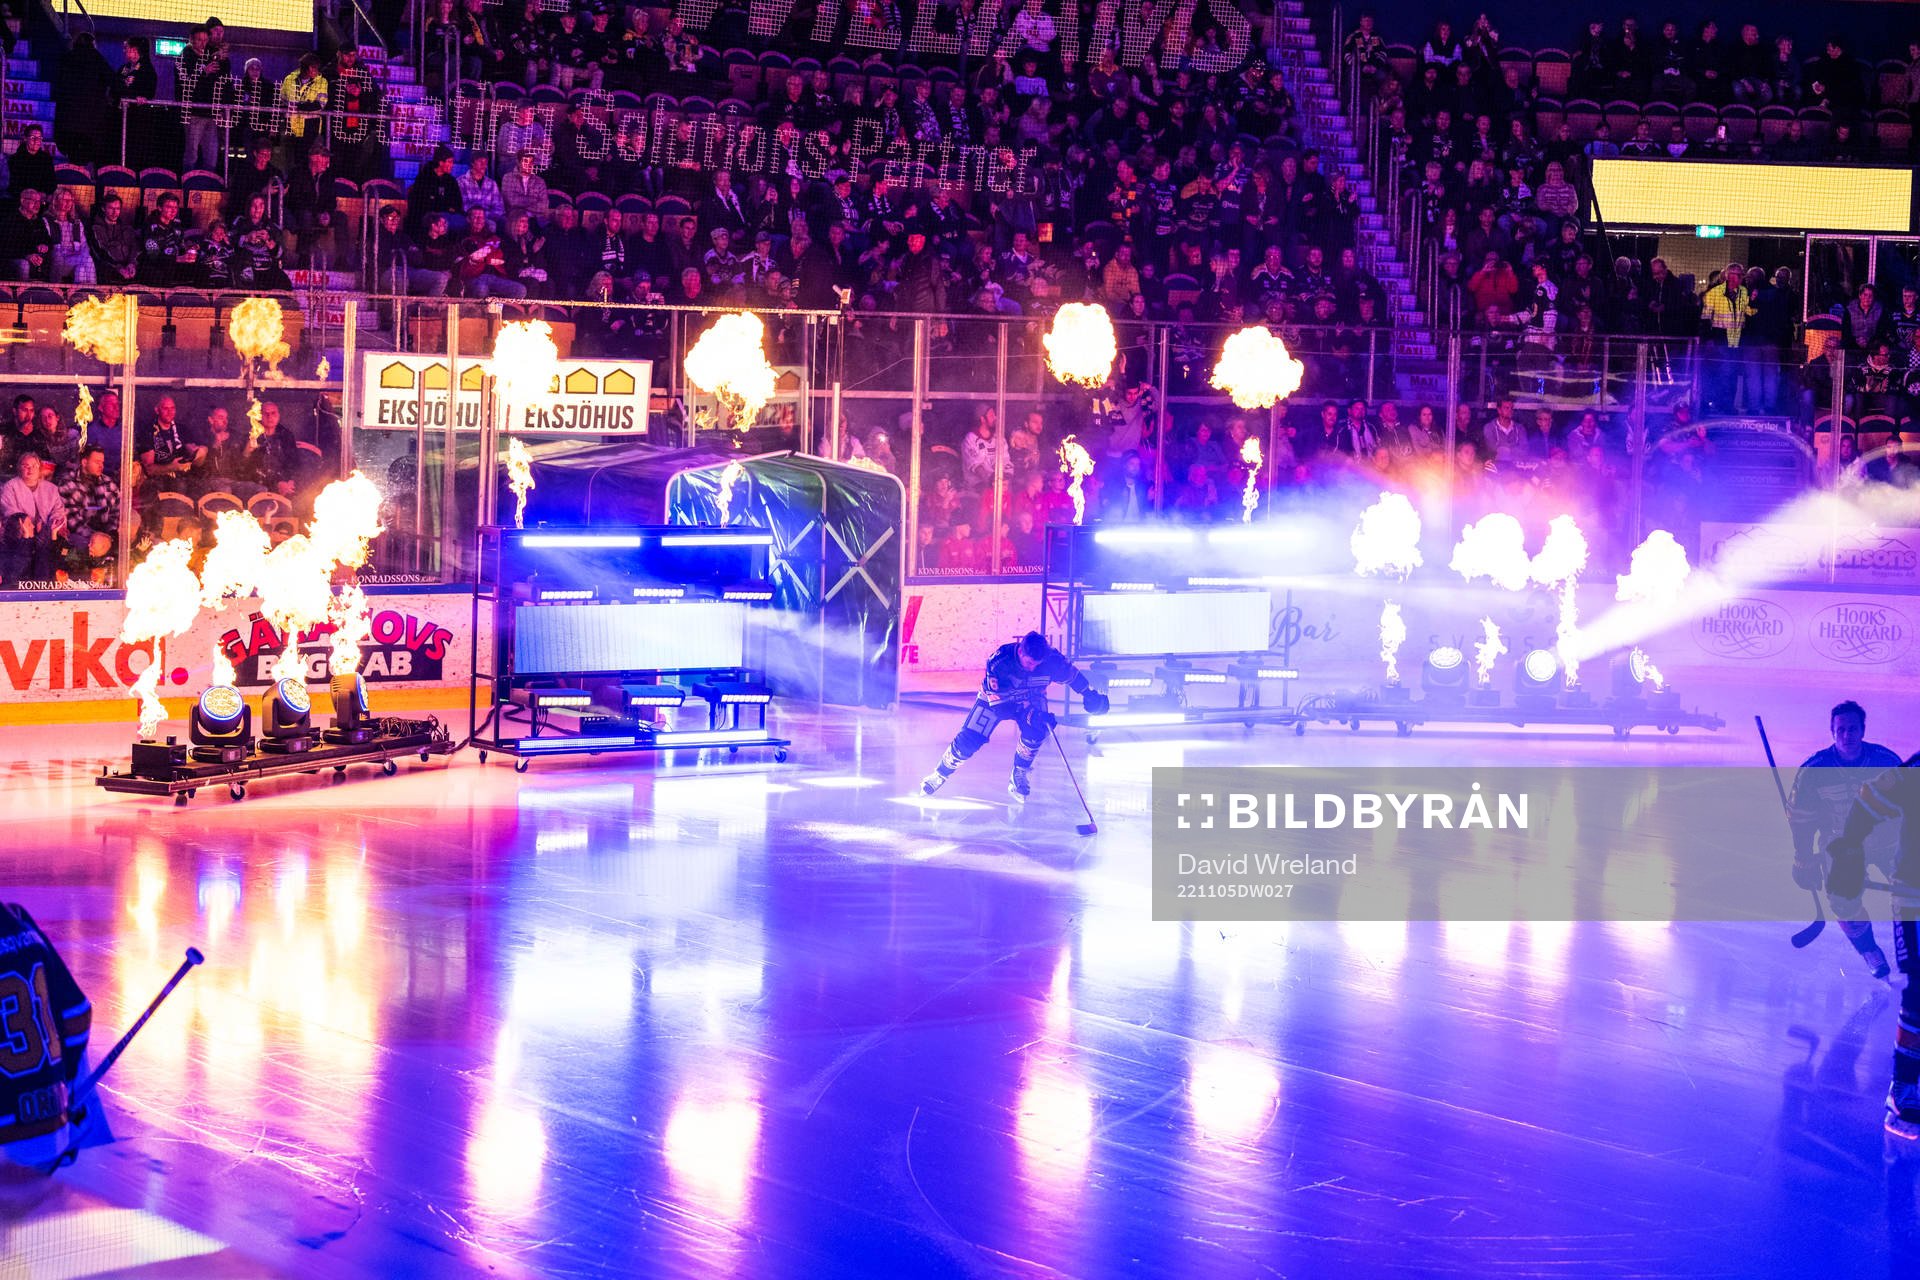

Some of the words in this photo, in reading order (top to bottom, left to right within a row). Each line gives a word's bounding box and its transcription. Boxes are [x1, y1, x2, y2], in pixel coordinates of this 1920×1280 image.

[575, 88, 829, 180] Solutions
[848, 116, 1037, 194] Partner
[378, 393, 490, 427] EKSJÖHU
[918, 567, 974, 576] KONRADSSONS
[1719, 602, 1768, 621] HOOKS
[1836, 606, 1887, 626] HOOKS
[363, 651, 412, 676] AB
